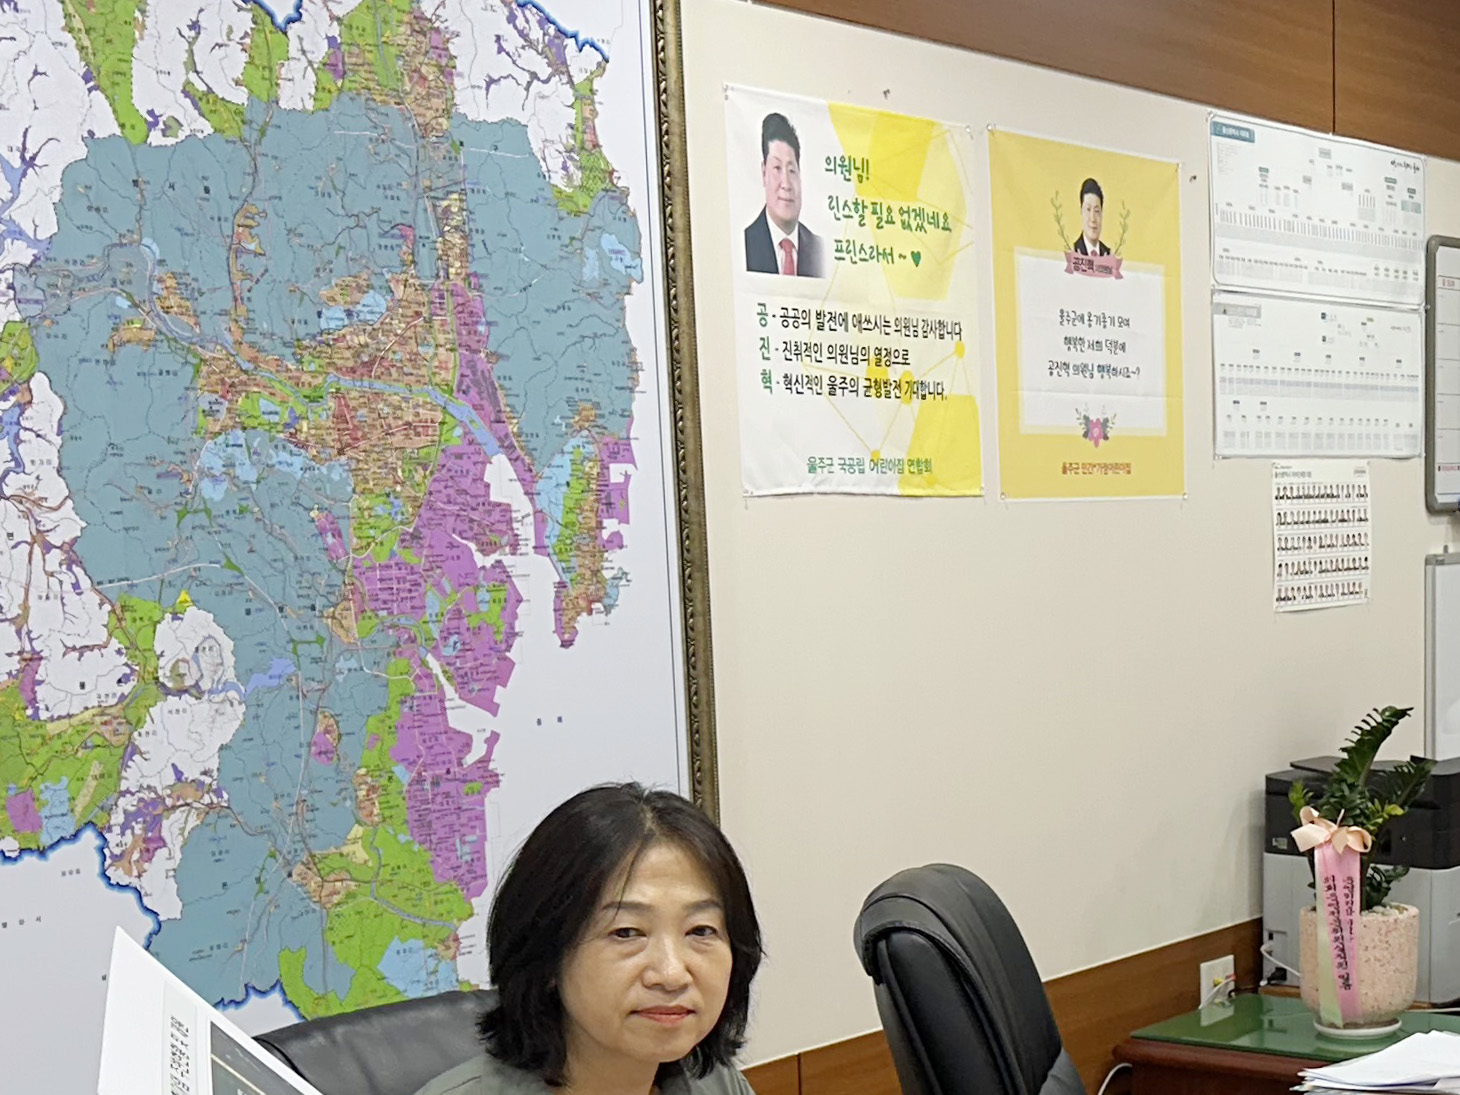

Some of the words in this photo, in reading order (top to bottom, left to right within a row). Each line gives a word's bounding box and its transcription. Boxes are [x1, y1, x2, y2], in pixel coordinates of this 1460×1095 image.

[824, 155, 870, 183] 의원님!
[828, 195, 868, 226] 린스할
[871, 202, 896, 229] 필요
[899, 205, 952, 234] 없겠네요
[756, 302, 769, 328] 공
[779, 307, 811, 329] 공공의
[815, 308, 849, 332] 발전에
[852, 313, 891, 335] 애쓰시는
[894, 317, 919, 338] 의원님
[921, 319, 963, 341] 감사합니다
[759, 336, 771, 361] 진
[782, 341, 823, 363] 진취적인
[827, 343, 870, 366] 의원님의
[874, 347, 910, 367] 열정으로
[761, 369, 773, 394] 혁
[783, 373, 823, 396] 혁신적인
[827, 375, 859, 397] 울주의
[863, 378, 902, 400] 균형발전
[807, 456, 834, 474] 울주군
[838, 457, 865, 474] 국공립
[869, 457, 905, 474] 어린이집
[907, 458, 932, 475] 연합회
